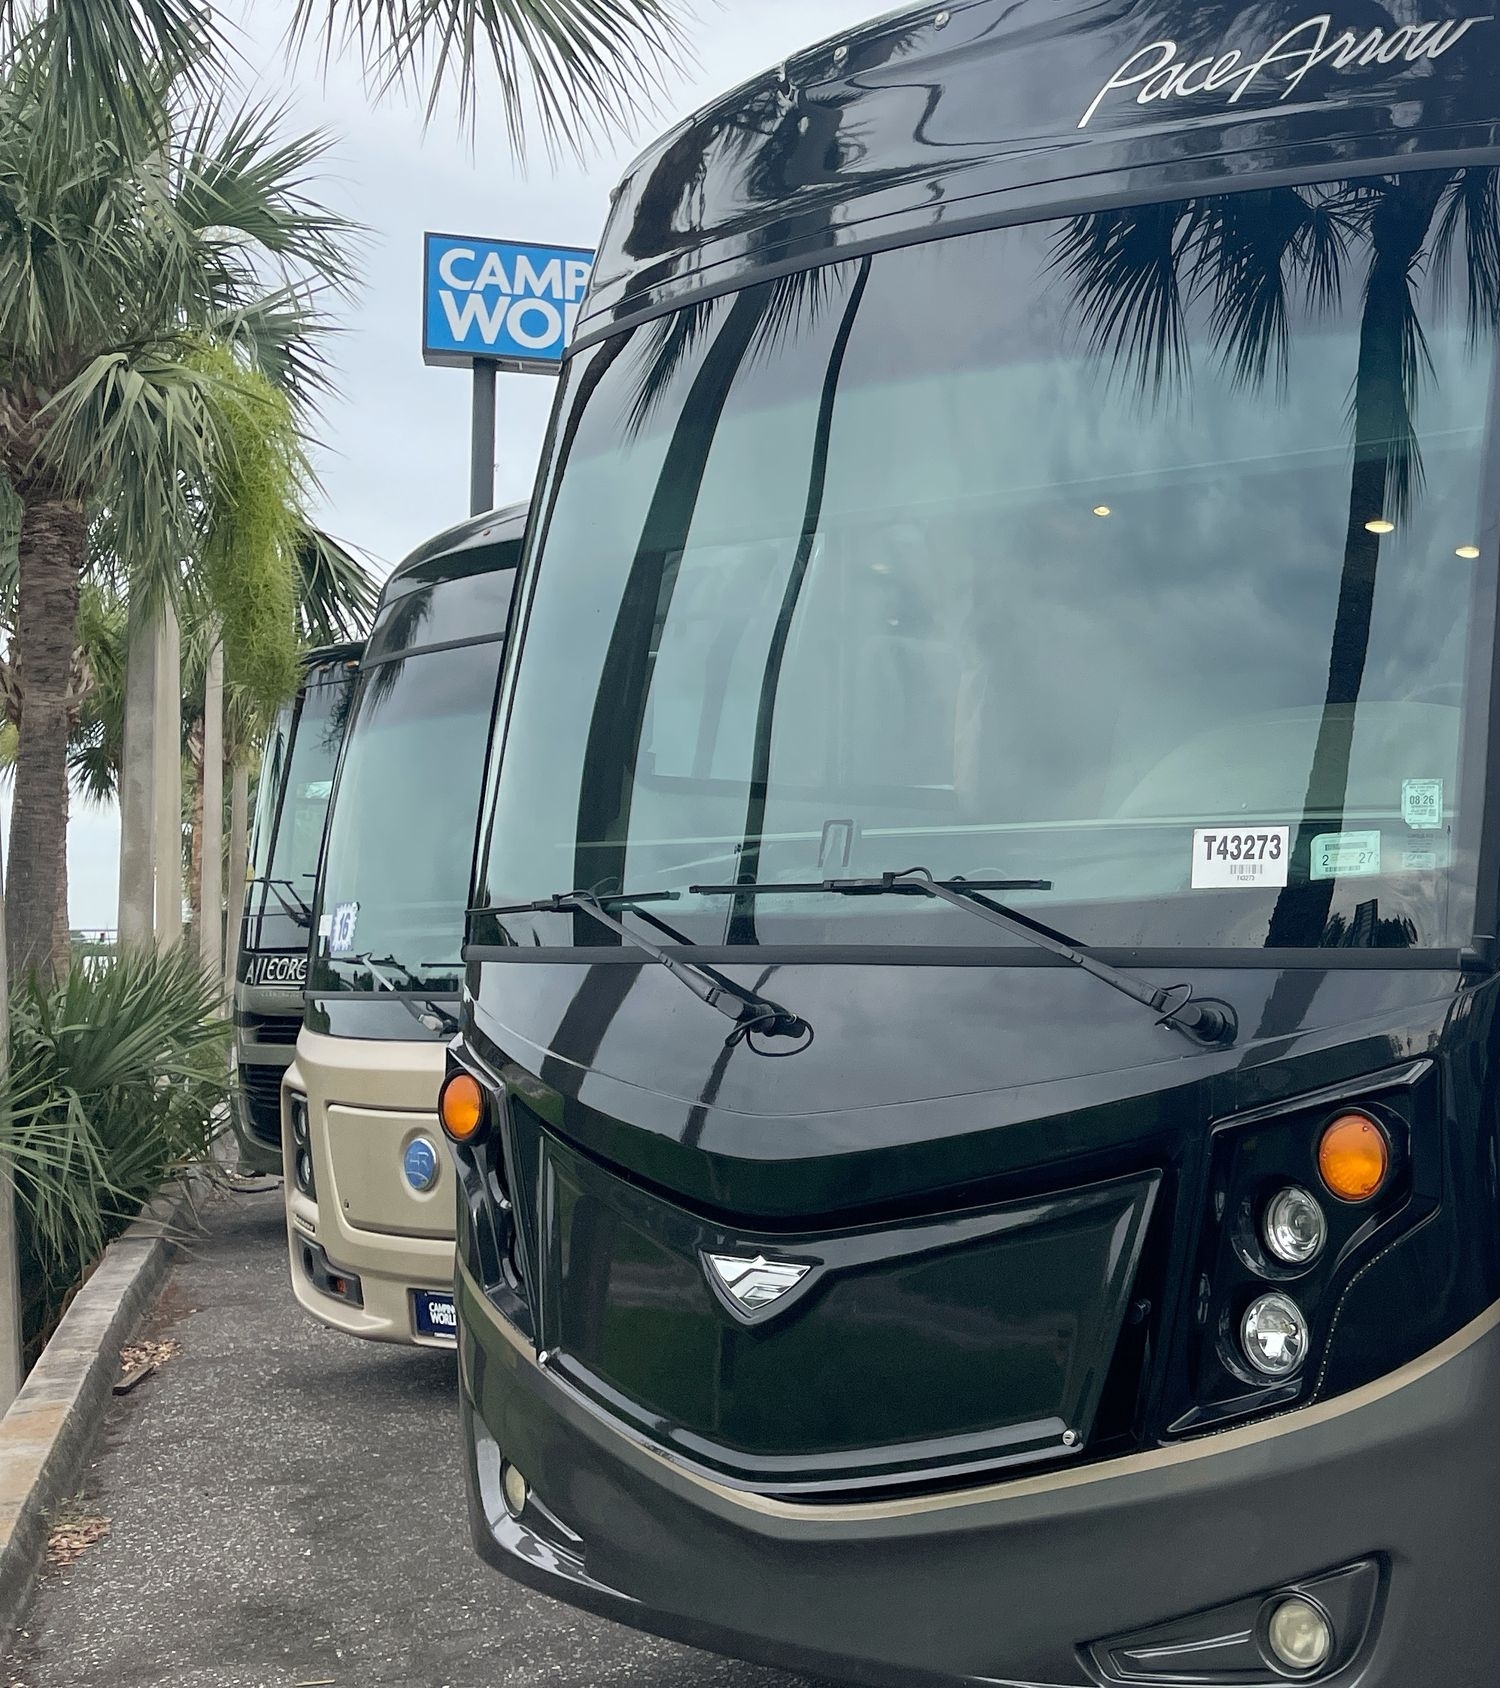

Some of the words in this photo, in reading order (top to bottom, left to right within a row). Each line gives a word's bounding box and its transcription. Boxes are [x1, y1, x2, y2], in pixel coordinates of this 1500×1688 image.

[1077, 41, 1241, 129] Pace
[1227, 14, 1495, 104] Arrow
[1203, 834, 1282, 861] T43273
